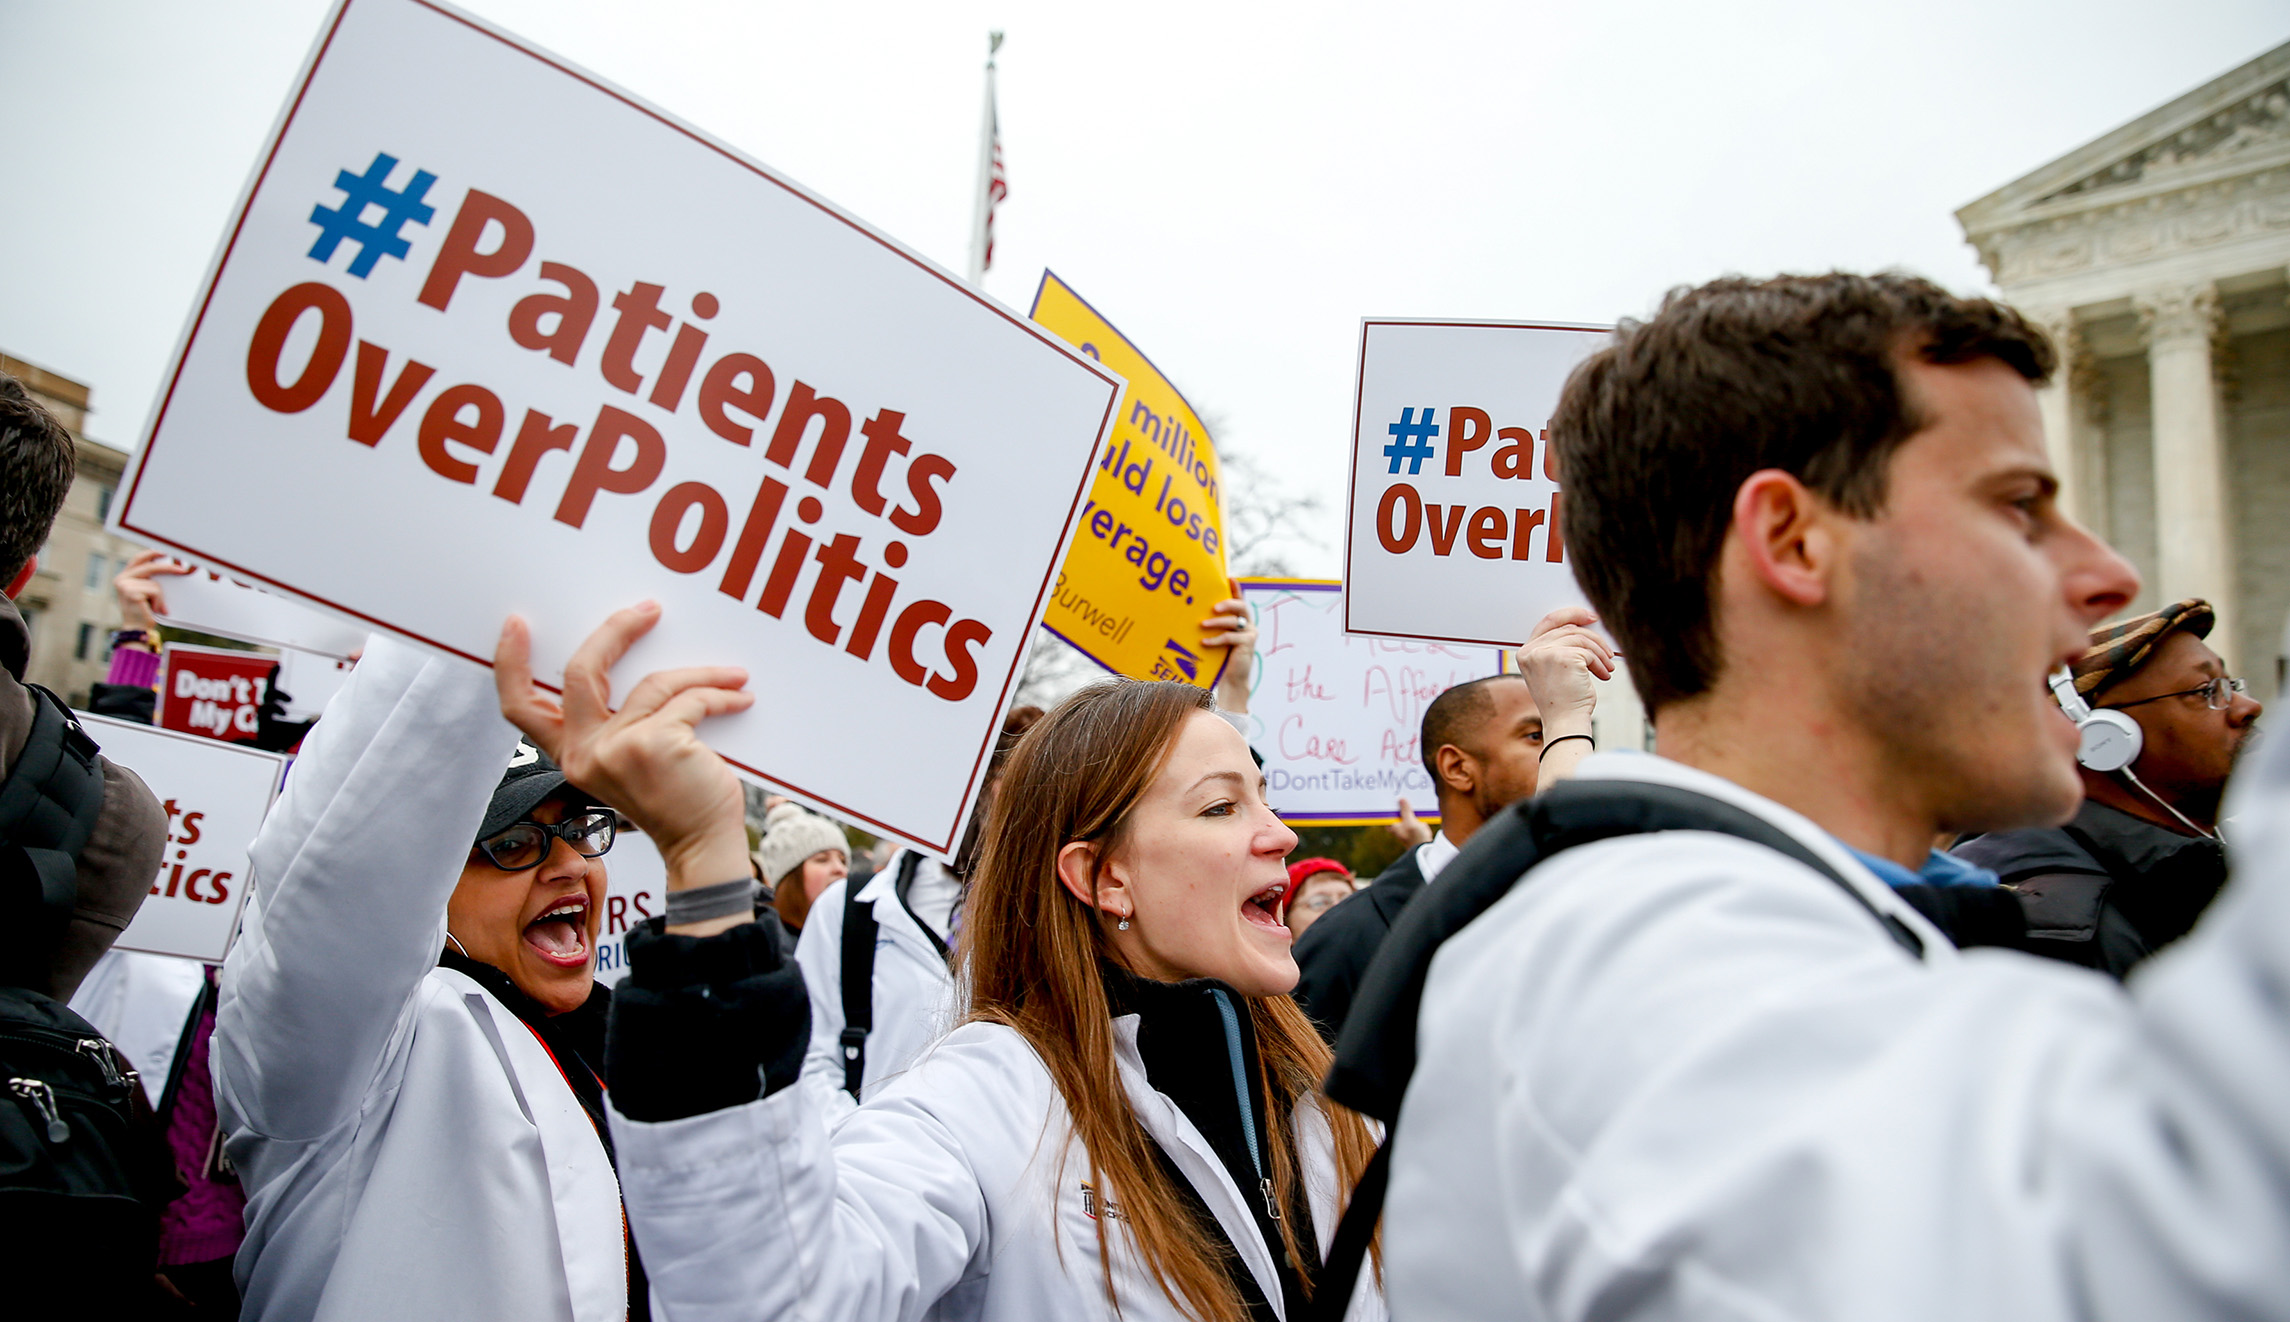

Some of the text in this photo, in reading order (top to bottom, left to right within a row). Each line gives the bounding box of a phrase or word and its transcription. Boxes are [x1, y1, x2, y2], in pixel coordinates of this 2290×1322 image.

[308, 153, 956, 535] #Patients
[247, 283, 992, 701] OverPolitics
[1129, 399, 1219, 507] million
[1155, 475, 1218, 555] lose
[175, 669, 252, 704] Don't
[188, 700, 234, 736] My
[1286, 665, 1335, 703] the
